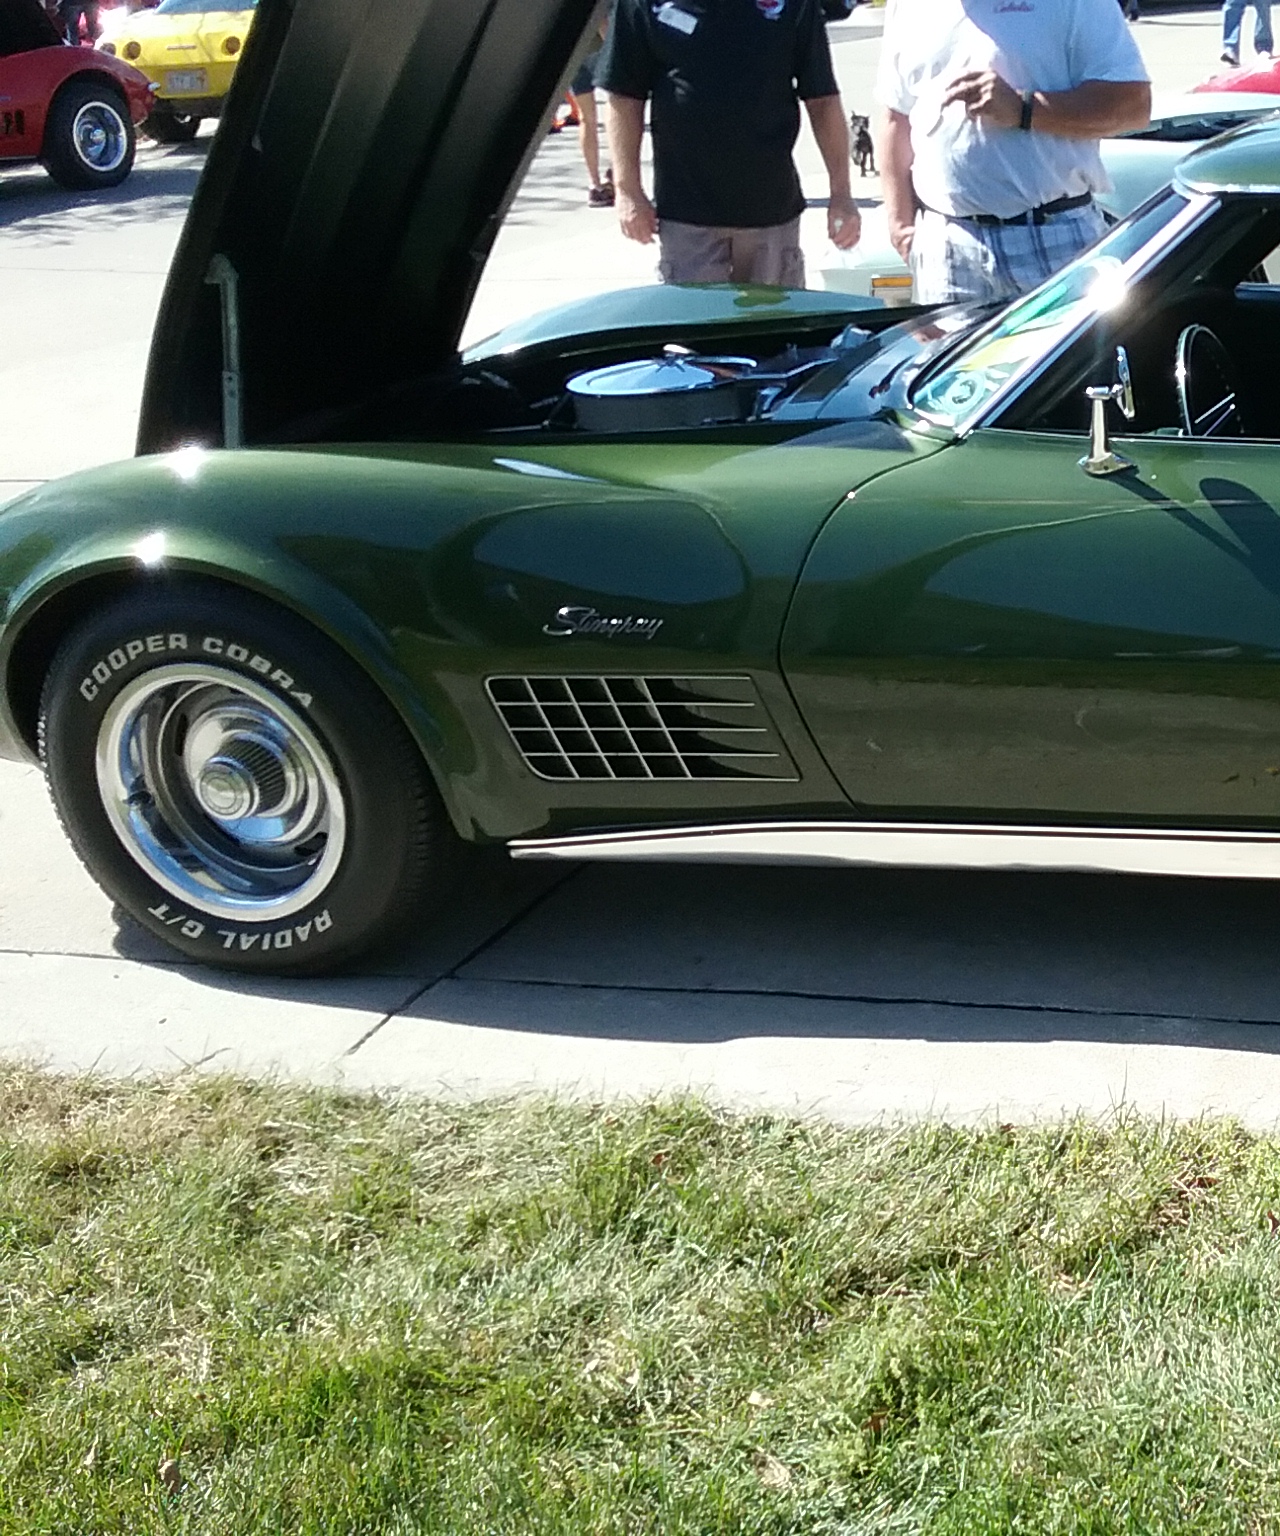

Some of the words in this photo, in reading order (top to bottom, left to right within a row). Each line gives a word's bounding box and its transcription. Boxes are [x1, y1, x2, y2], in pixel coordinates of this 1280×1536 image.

[542, 606, 664, 640] Stingray
[79, 633, 188, 701] COOPER
[202, 636, 313, 708] COBRA
[147, 903, 206, 939] G/T
[217, 908, 334, 950] RADIAL
